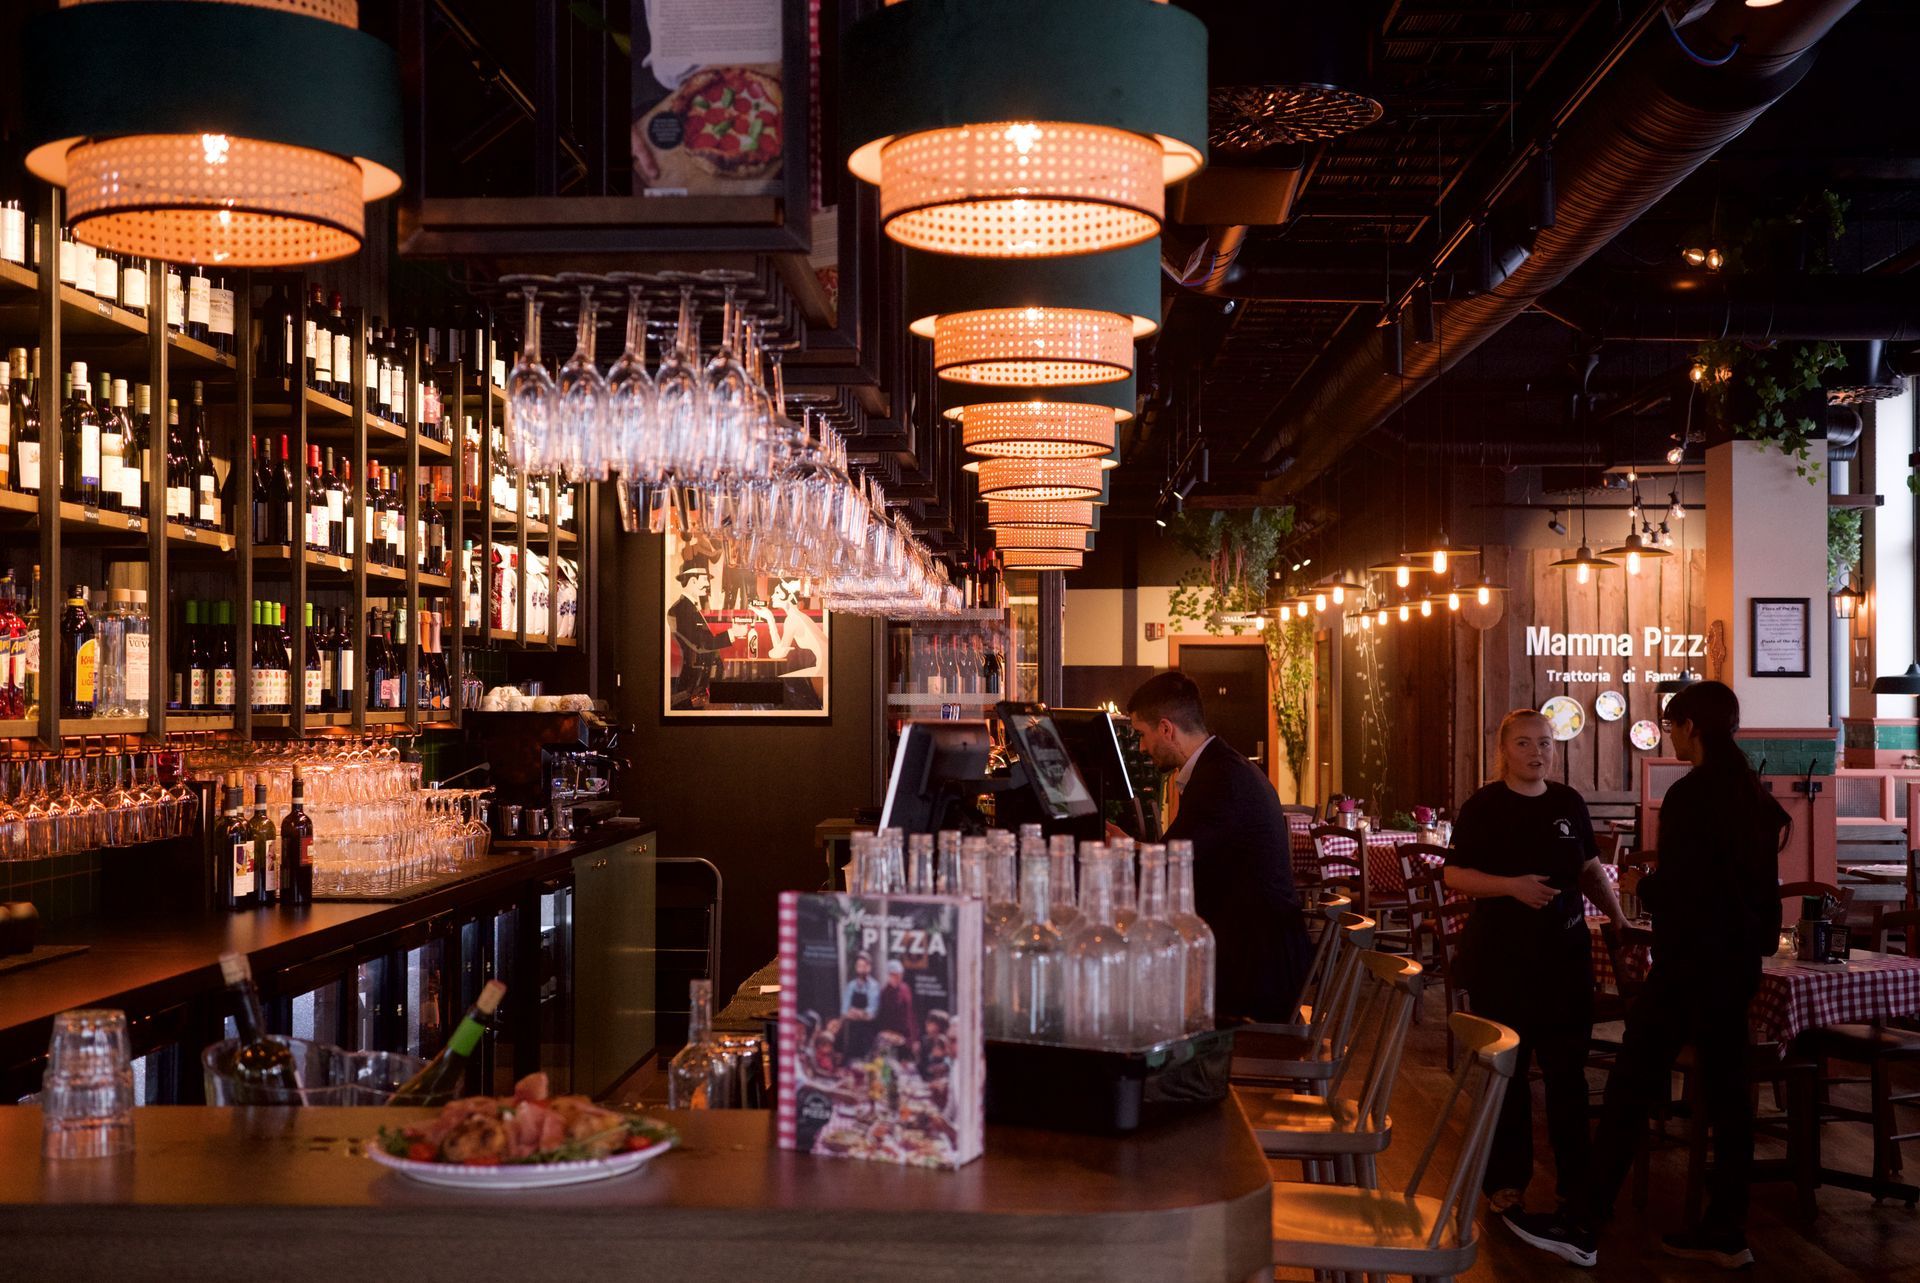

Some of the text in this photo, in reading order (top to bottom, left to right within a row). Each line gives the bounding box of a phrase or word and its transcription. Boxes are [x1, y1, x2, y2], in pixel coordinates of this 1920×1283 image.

[1526, 626, 1633, 657] Mamma
[1547, 666, 1703, 683] Trattoria di Familia
[863, 929, 947, 956] PIZZA
